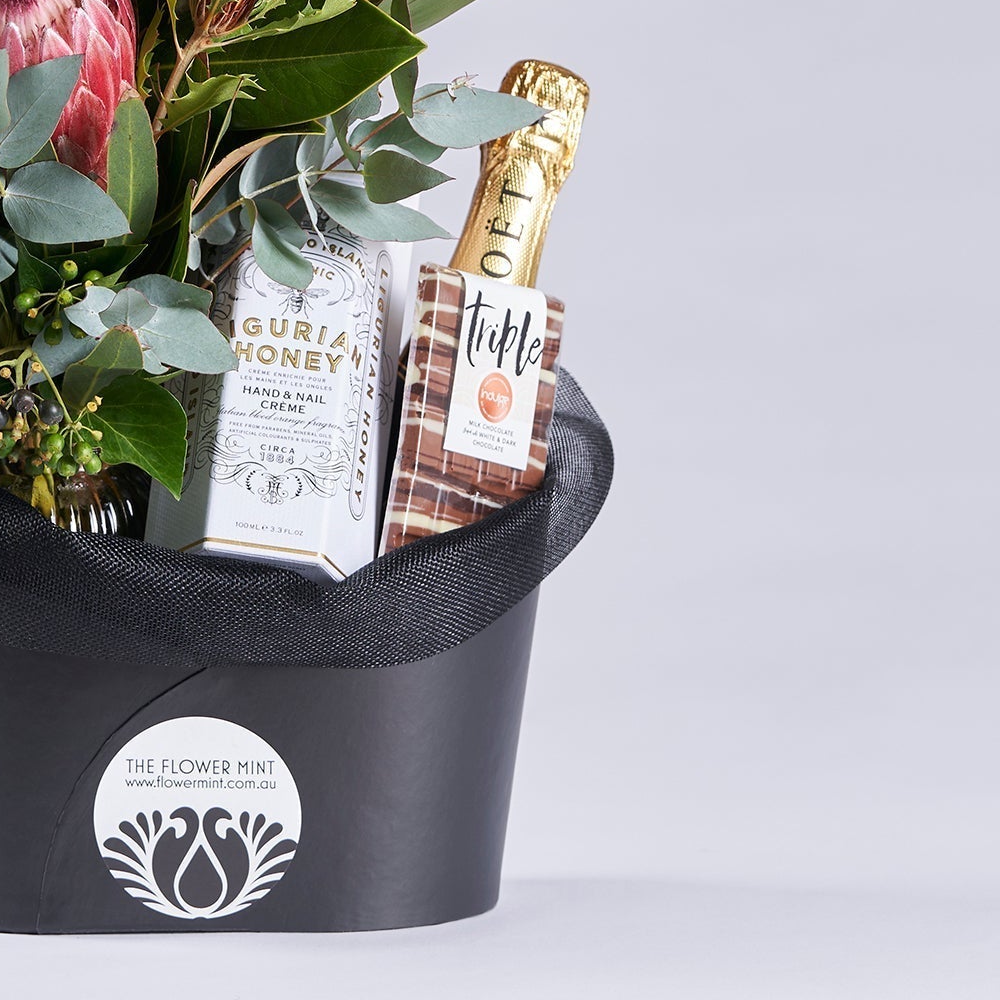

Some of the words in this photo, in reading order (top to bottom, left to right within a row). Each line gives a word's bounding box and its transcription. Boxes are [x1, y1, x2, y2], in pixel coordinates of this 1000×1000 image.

[481, 180, 533, 279] OËT
[366, 268, 388, 401] LIGURIAN
[465, 290, 545, 376] triple
[229, 317, 362, 370] IGURIAN
[235, 341, 344, 374] HONEY
[255, 376, 277, 384] MAINS
[290, 380, 303, 388] LES
[308, 375, 327, 383] POUR
[242, 385, 281, 398] HAND
[283, 390, 292, 400] &
[295, 391, 327, 404] NAIL
[260, 400, 306, 414] CRÈME
[244, 422, 260, 430] FROM
[482, 423, 514, 437] CHOCOLATE
[260, 444, 295, 454] CIRCA
[472, 439, 504, 453] CHOCOLATE
[260, 451, 295, 465] 1884
[354, 410, 371, 503] HONEY
[126, 758, 155, 774] THE
[161, 759, 231, 775] FLOWER
[237, 760, 276, 775] MINT
[125, 775, 277, 790] www.flowermint.com.au
